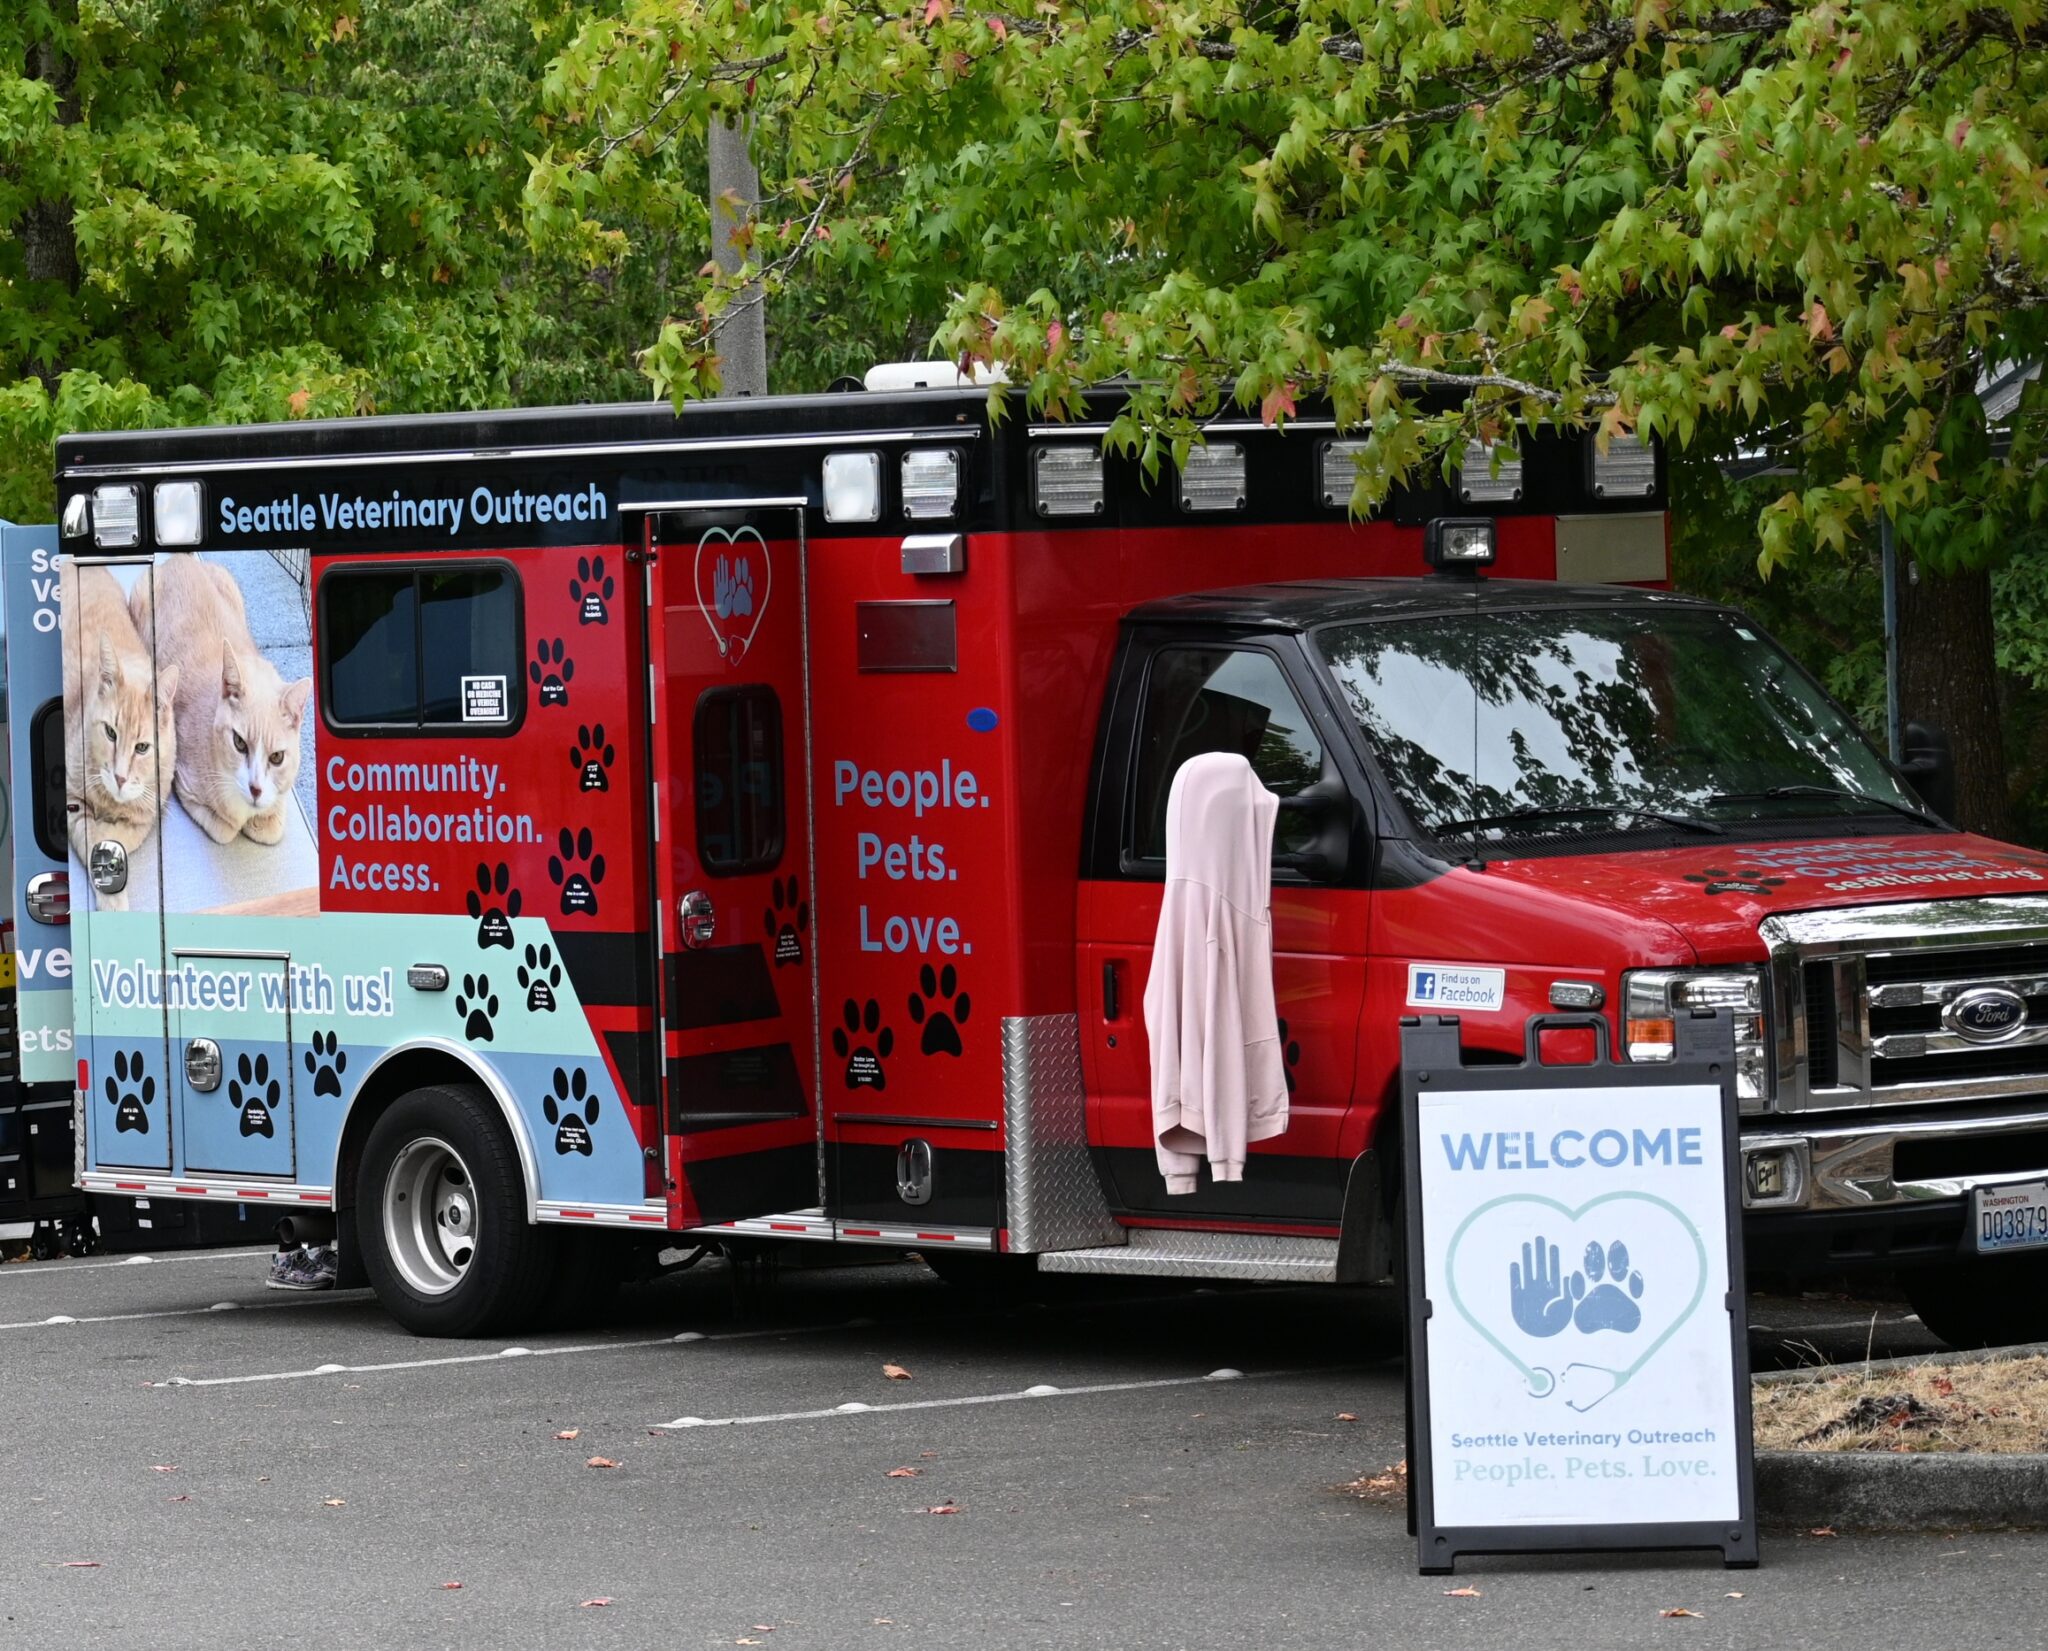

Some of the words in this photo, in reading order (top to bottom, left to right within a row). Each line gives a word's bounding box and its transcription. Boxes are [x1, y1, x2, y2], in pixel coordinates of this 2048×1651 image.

[220, 494, 316, 533] Seattle
[319, 490, 464, 535] Veterinary
[470, 482, 607, 525] Outreach
[327, 755, 506, 799] Community.
[834, 758, 990, 817] People.
[328, 804, 543, 843] Collaboration.
[857, 832, 957, 881] Pets.
[1735, 840, 1896, 856] Seattle
[1736, 849, 1967, 867] Veterinary
[329, 854, 440, 892] Access.
[1795, 858, 2000, 877] Outreach
[1825, 868, 2044, 891] seattlevet.org
[860, 905, 972, 955] Love.
[92, 960, 251, 1010] Volunteer
[260, 963, 334, 1013] with
[343, 967, 393, 1015] us!
[1440, 986, 1495, 1003] Facebook
[1441, 973, 1458, 984] Find
[1460, 976, 1469, 984] us
[1470, 977, 1481, 985] on
[1975, 1002, 2011, 1024] Ford
[1440, 1127, 1703, 1171] WELCOME
[1983, 1196, 2029, 1207] WASHINGTON
[1451, 1432, 1519, 1448] Seattle
[1524, 1430, 1621, 1448] Veterinary
[1627, 1428, 1716, 1445] Outreach
[1453, 1457, 1556, 1487] People.
[1565, 1456, 1633, 1479] Pets.
[1642, 1455, 1717, 1477] Love.
